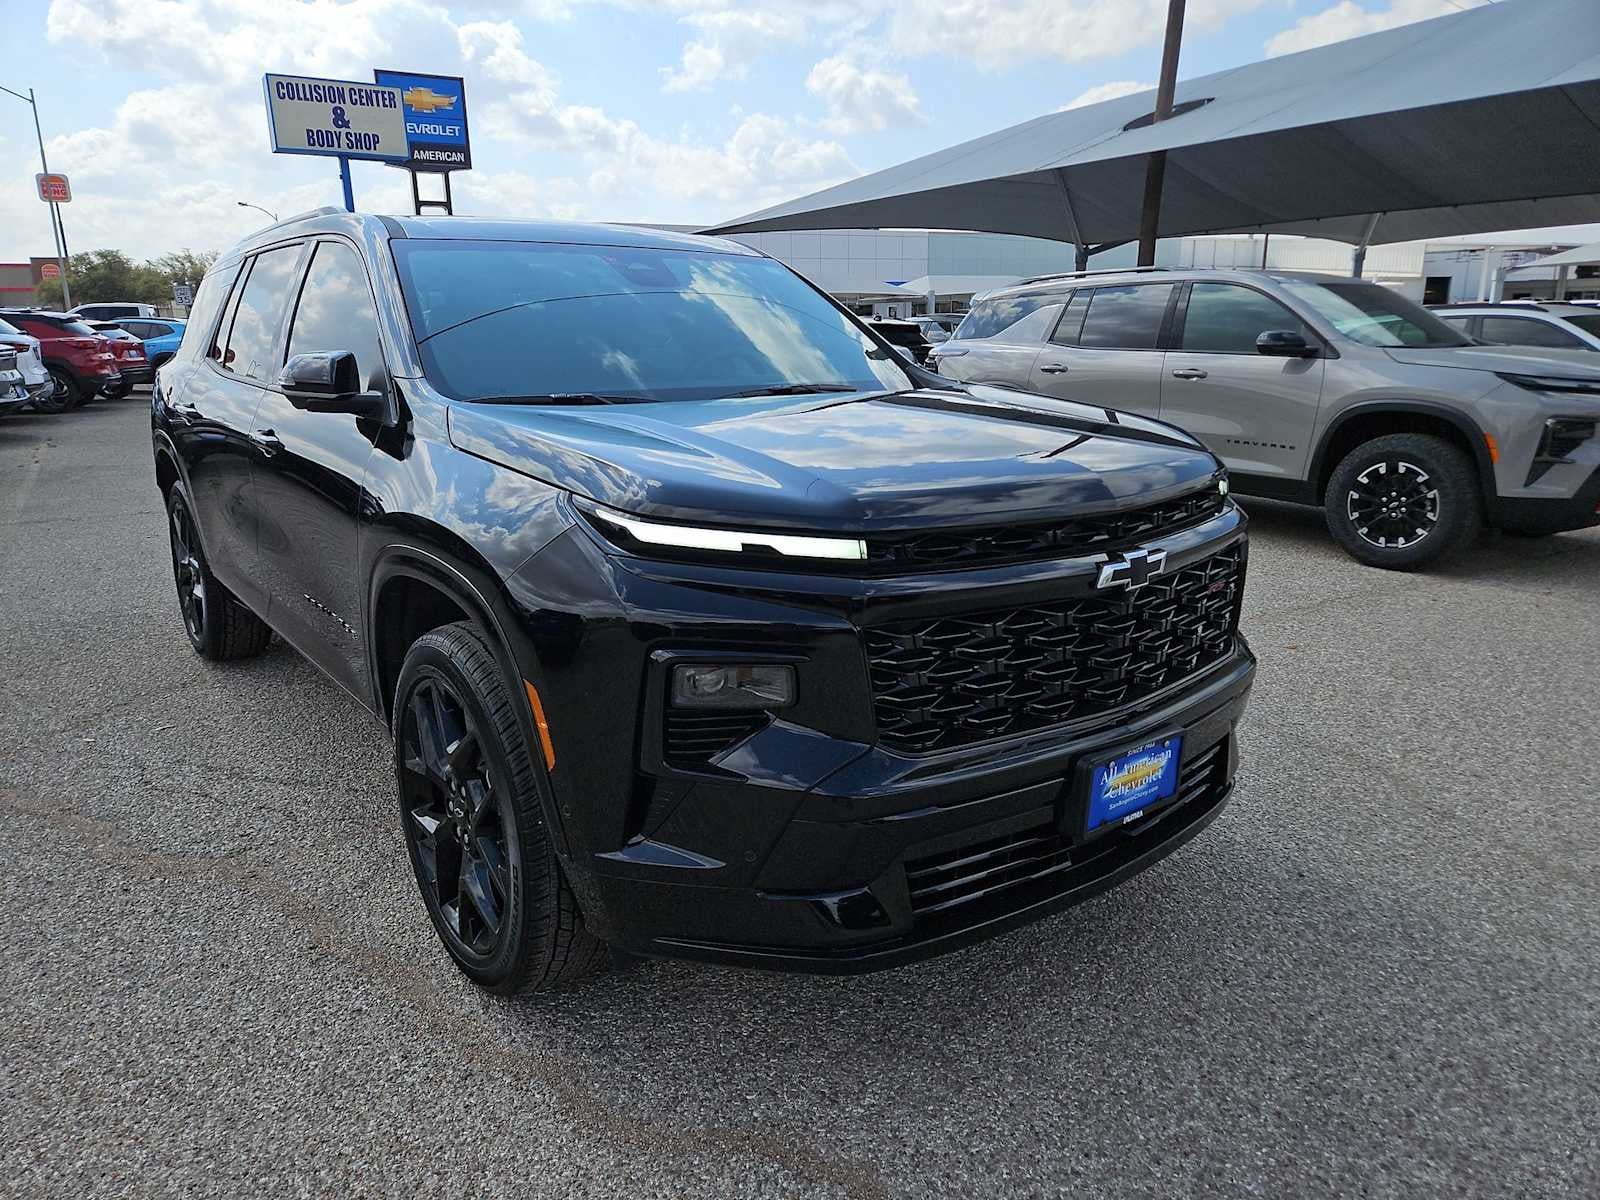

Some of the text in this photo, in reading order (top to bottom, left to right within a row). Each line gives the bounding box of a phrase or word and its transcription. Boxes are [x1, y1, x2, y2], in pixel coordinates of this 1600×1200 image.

[276, 81, 397, 109] COLLISION CENTER
[332, 106, 350, 129] &
[306, 128, 380, 151] BODY SHOP
[406, 122, 460, 137] EVROLET
[413, 150, 465, 162] AMERICAN
[177, 296, 191, 304] 35
[1225, 439, 1296, 450] TRAVERSE
[1100, 749, 1172, 785] All American
[1109, 769, 1162, 799] Chevrolet
